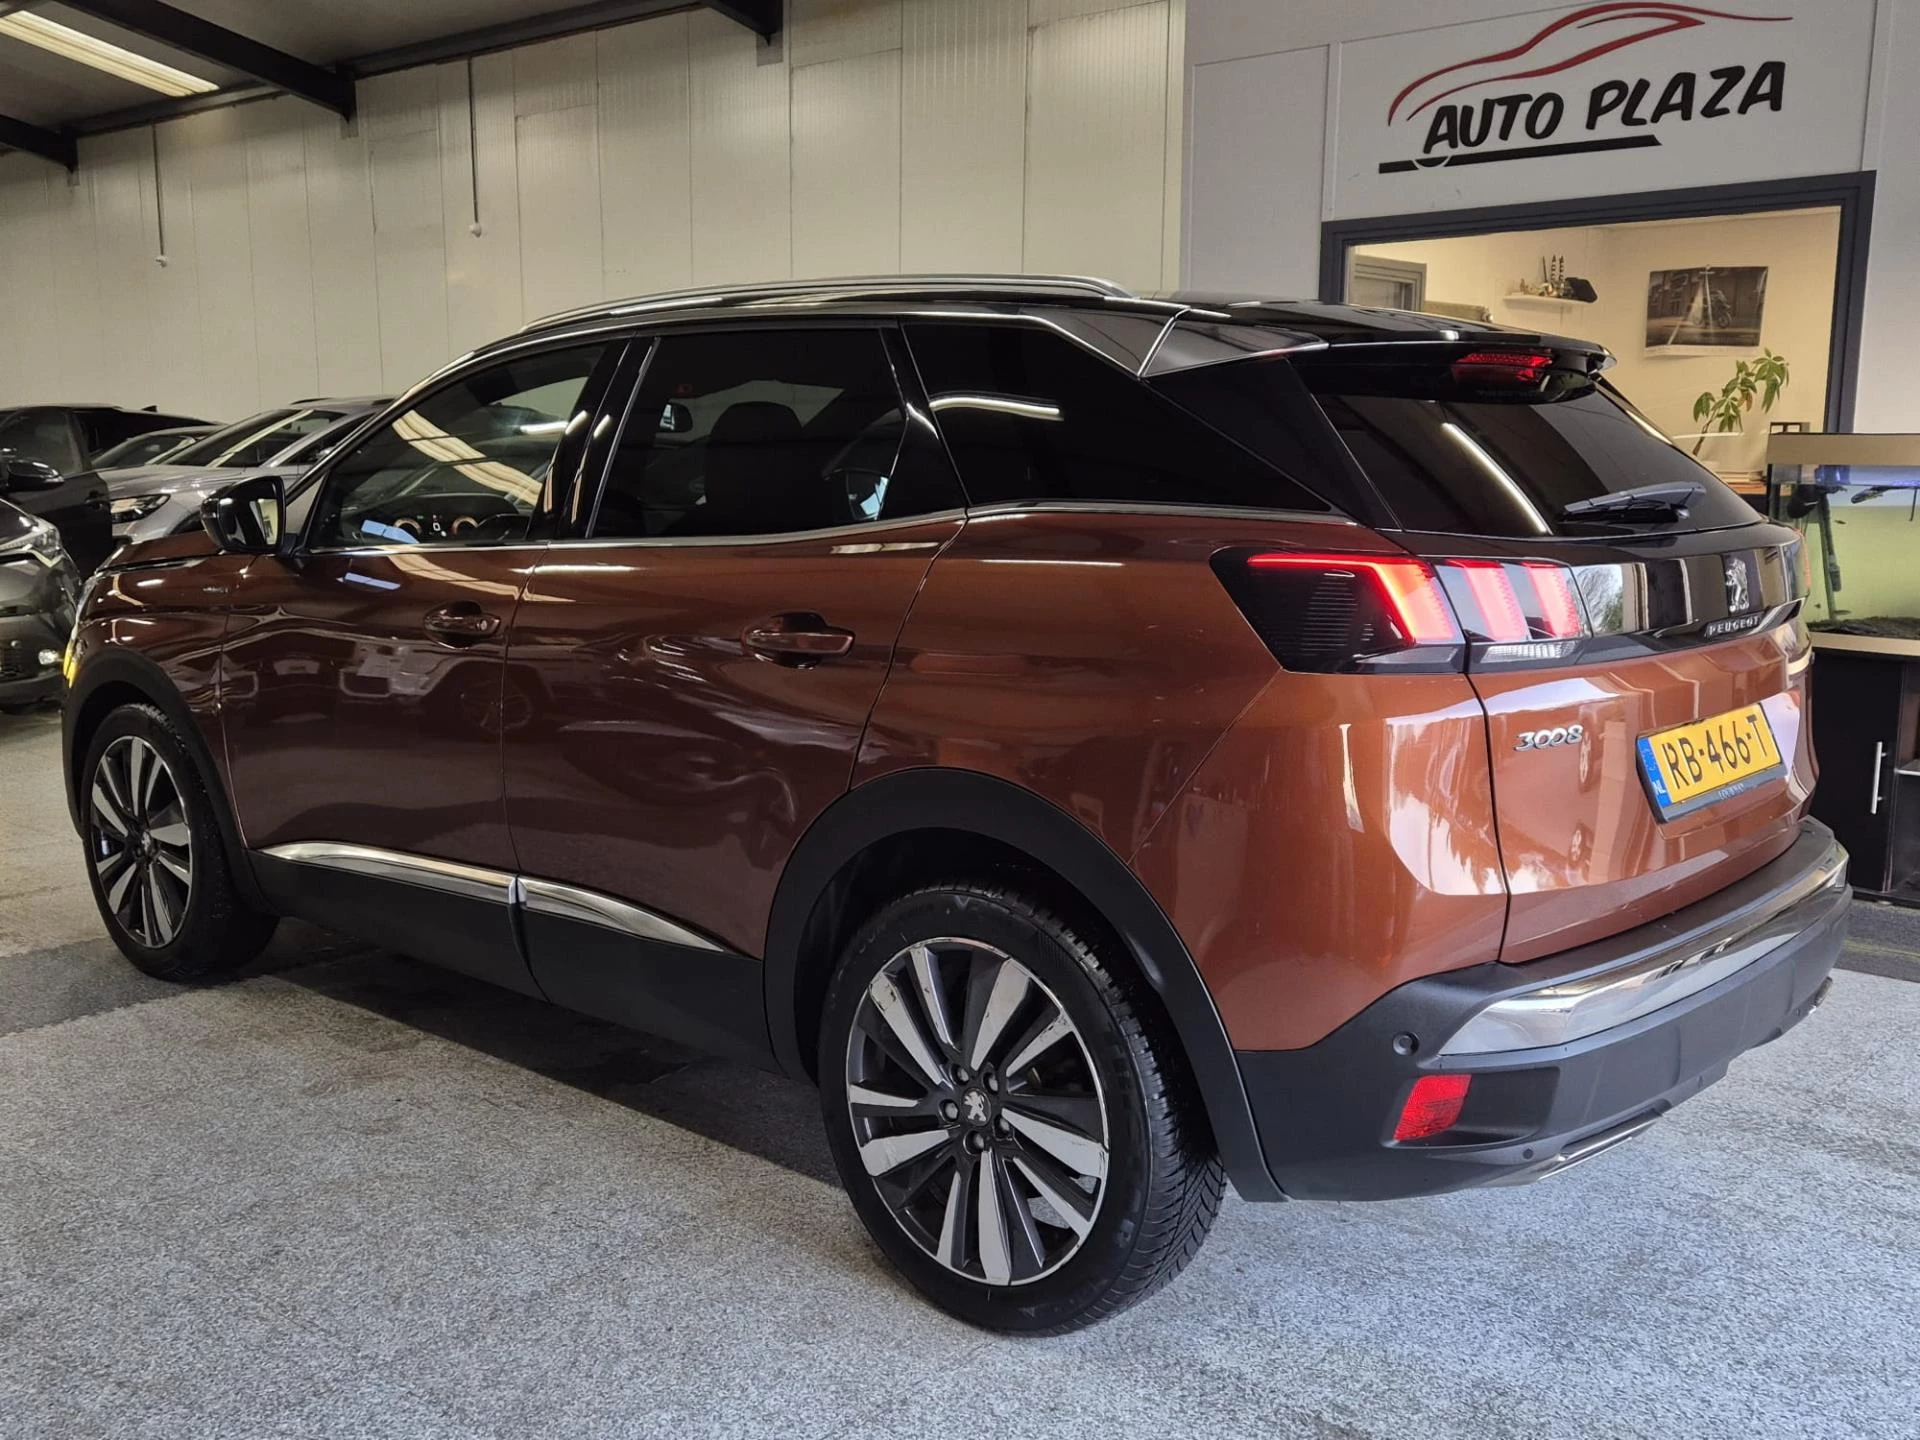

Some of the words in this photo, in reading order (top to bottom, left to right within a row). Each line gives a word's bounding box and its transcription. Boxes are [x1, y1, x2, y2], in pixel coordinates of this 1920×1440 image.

[1423, 92, 1565, 154] AUTO
[1585, 61, 1786, 131] PLAZA
[1708, 615, 1760, 636] PEUGEOT
[1514, 724, 1584, 752] 3008
[1661, 713, 1768, 790] RB-466-T
[1652, 779, 1667, 795] NL
